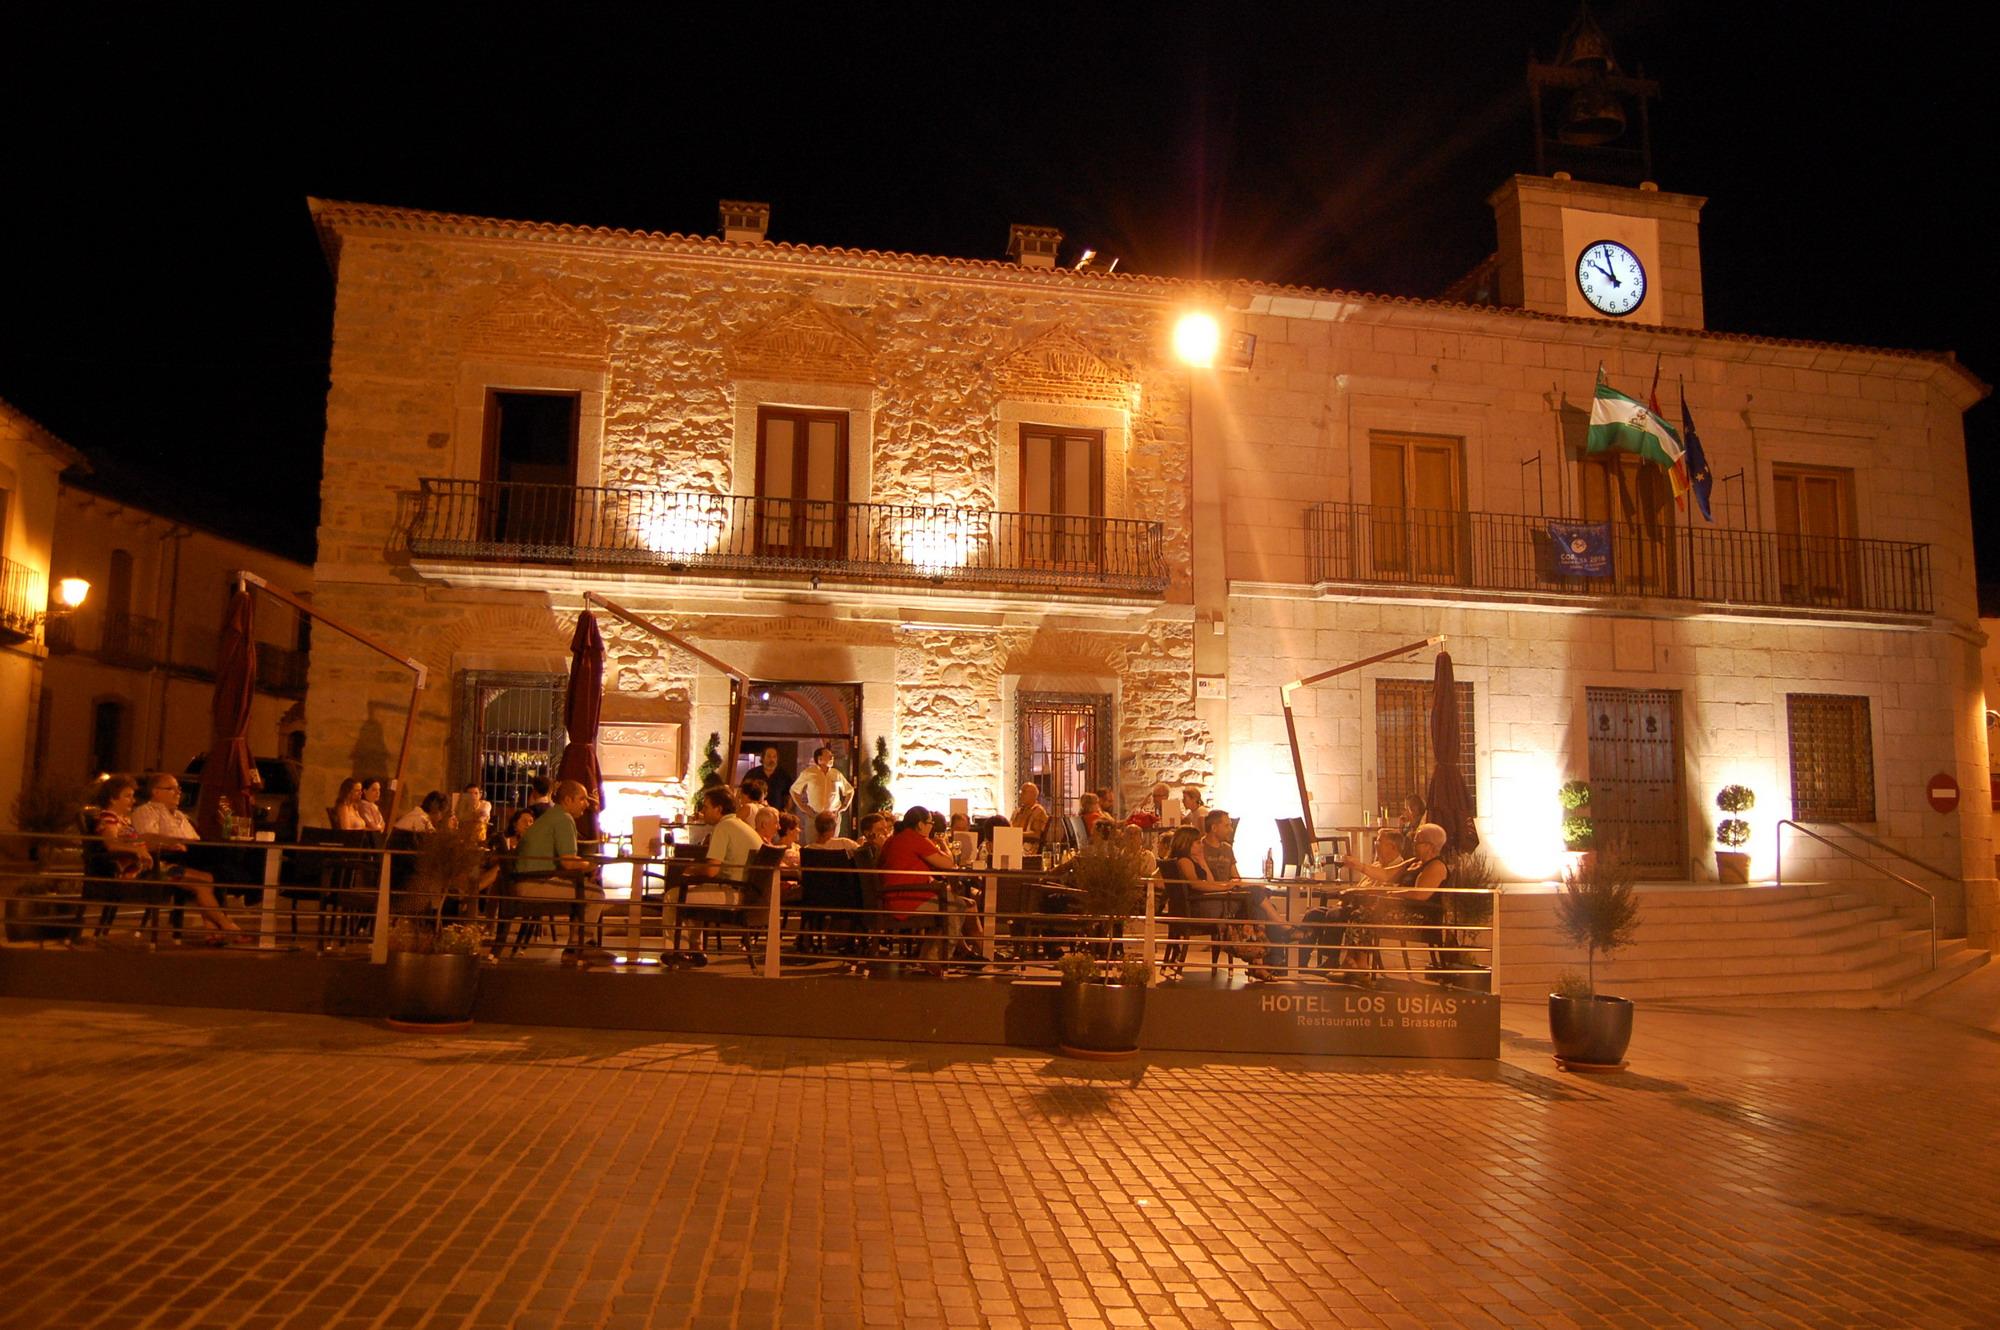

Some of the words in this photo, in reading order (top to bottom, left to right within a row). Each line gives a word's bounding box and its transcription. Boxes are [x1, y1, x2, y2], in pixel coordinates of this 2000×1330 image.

[1594, 251, 1601, 259] 11
[1586, 260, 1595, 268] 10
[1630, 264, 1635, 272] 2
[1582, 272, 1589, 280] 9
[1634, 277, 1639, 286] 3
[1587, 285, 1593, 293] 8
[1596, 296, 1602, 304] 7
[1610, 301, 1616, 309] 6
[1262, 994, 1331, 1013] HOTEL
[1344, 996, 1386, 1013] LOS
[1396, 994, 1457, 1014] USÍAS
[1297, 1015, 1371, 1027] Restaurante
[1379, 1016, 1394, 1027] La
